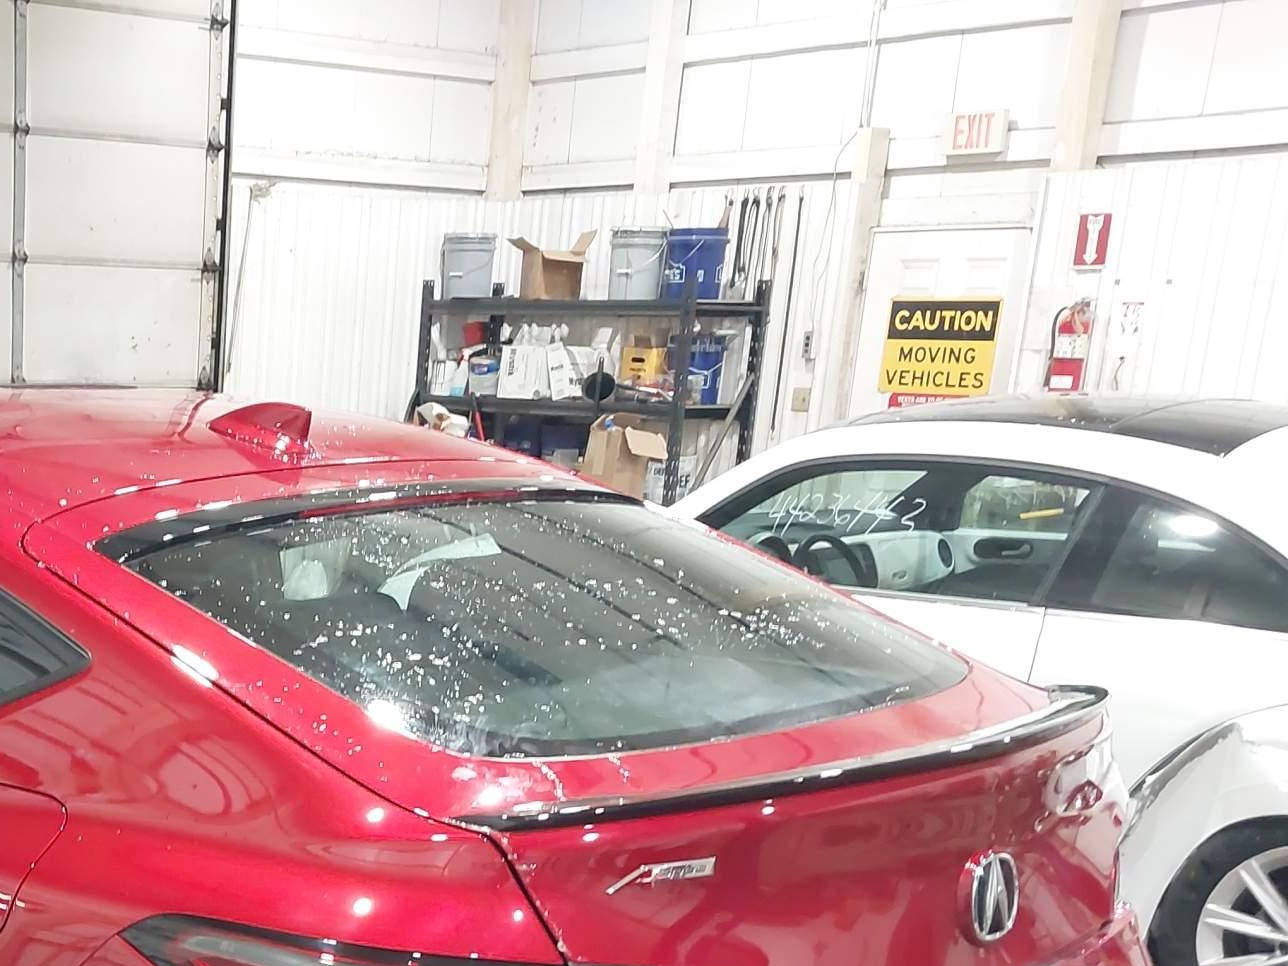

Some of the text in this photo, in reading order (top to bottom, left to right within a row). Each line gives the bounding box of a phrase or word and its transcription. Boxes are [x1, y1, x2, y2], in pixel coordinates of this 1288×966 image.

[952, 113, 995, 150] EXIT
[894, 309, 993, 331] CAUTION
[898, 346, 976, 364] MOVING
[886, 369, 984, 389] VEHICLES
[679, 474, 691, 488] EF
